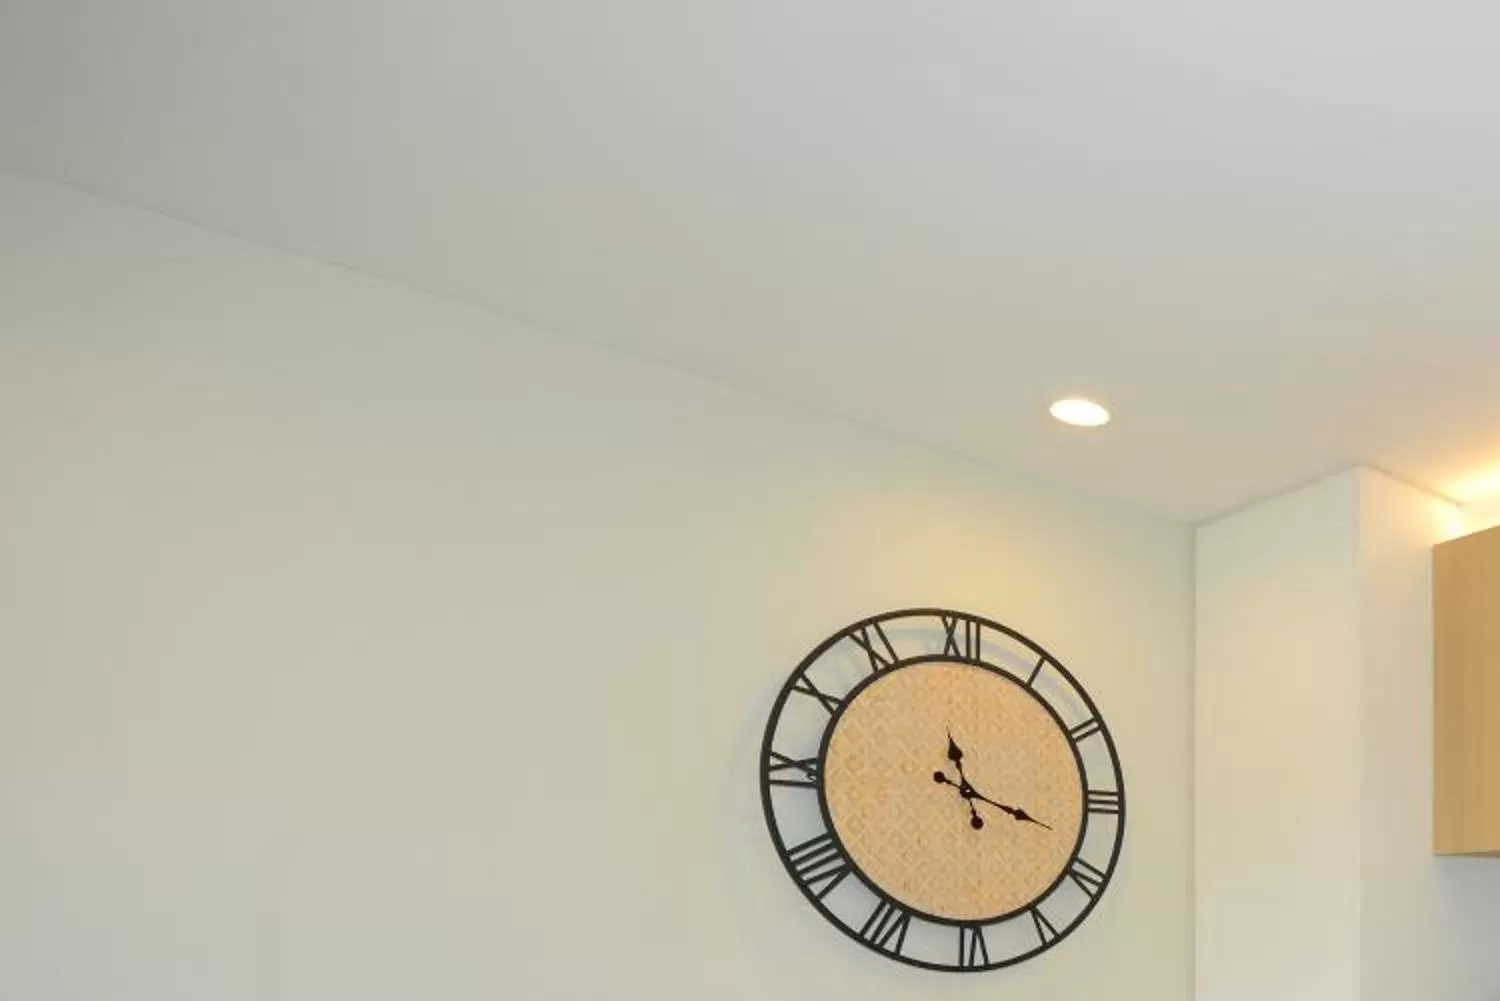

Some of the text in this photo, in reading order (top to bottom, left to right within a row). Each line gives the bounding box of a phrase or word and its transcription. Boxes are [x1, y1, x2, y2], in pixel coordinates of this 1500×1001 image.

[849, 621, 899, 671] XI
[941, 614, 980, 663] XII
[793, 673, 843, 715] X
[1069, 716, 1101, 743] II
[769, 751, 819, 789] IX
[1086, 789, 1120, 814] III
[786, 831, 851, 901] VIII
[1069, 857, 1108, 900] IV
[860, 900, 911, 955] VII
[959, 924, 989, 967] VI
[1030, 905, 1060, 946] V
